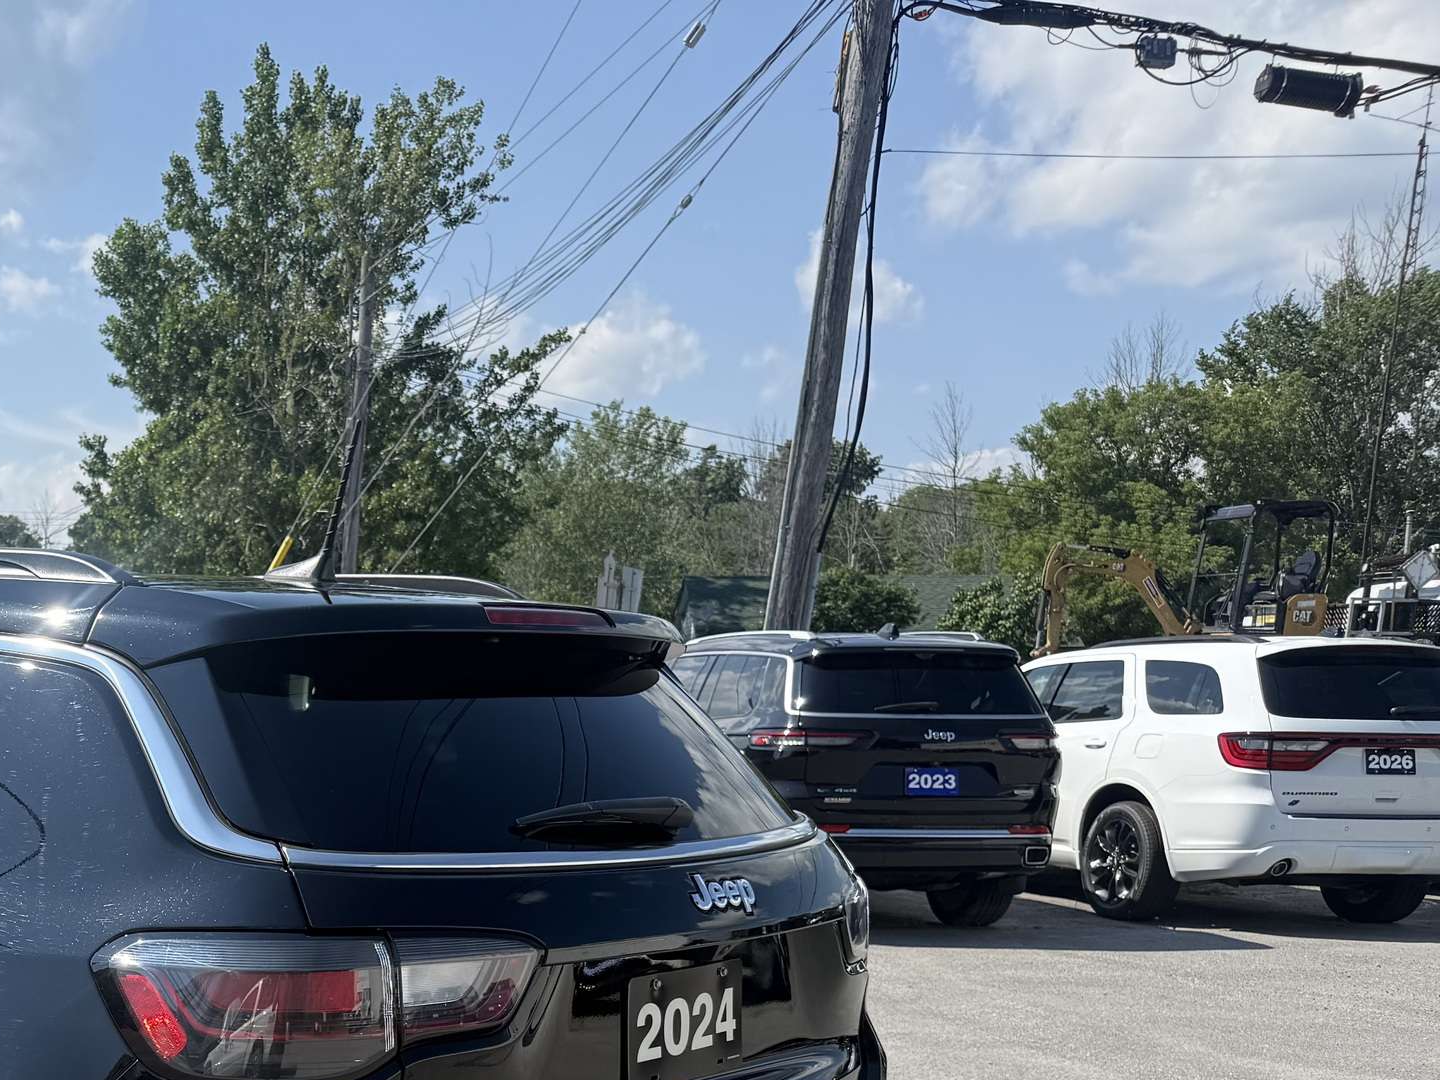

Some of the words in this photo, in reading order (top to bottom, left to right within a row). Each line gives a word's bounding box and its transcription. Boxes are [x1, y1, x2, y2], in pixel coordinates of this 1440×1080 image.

[1292, 609, 1313, 623] CAT
[924, 729, 956, 742] Jeep
[1367, 754, 1414, 769] 2026
[908, 774, 956, 789] 2023
[689, 873, 755, 914] Jeep
[636, 987, 736, 1063] 2024
